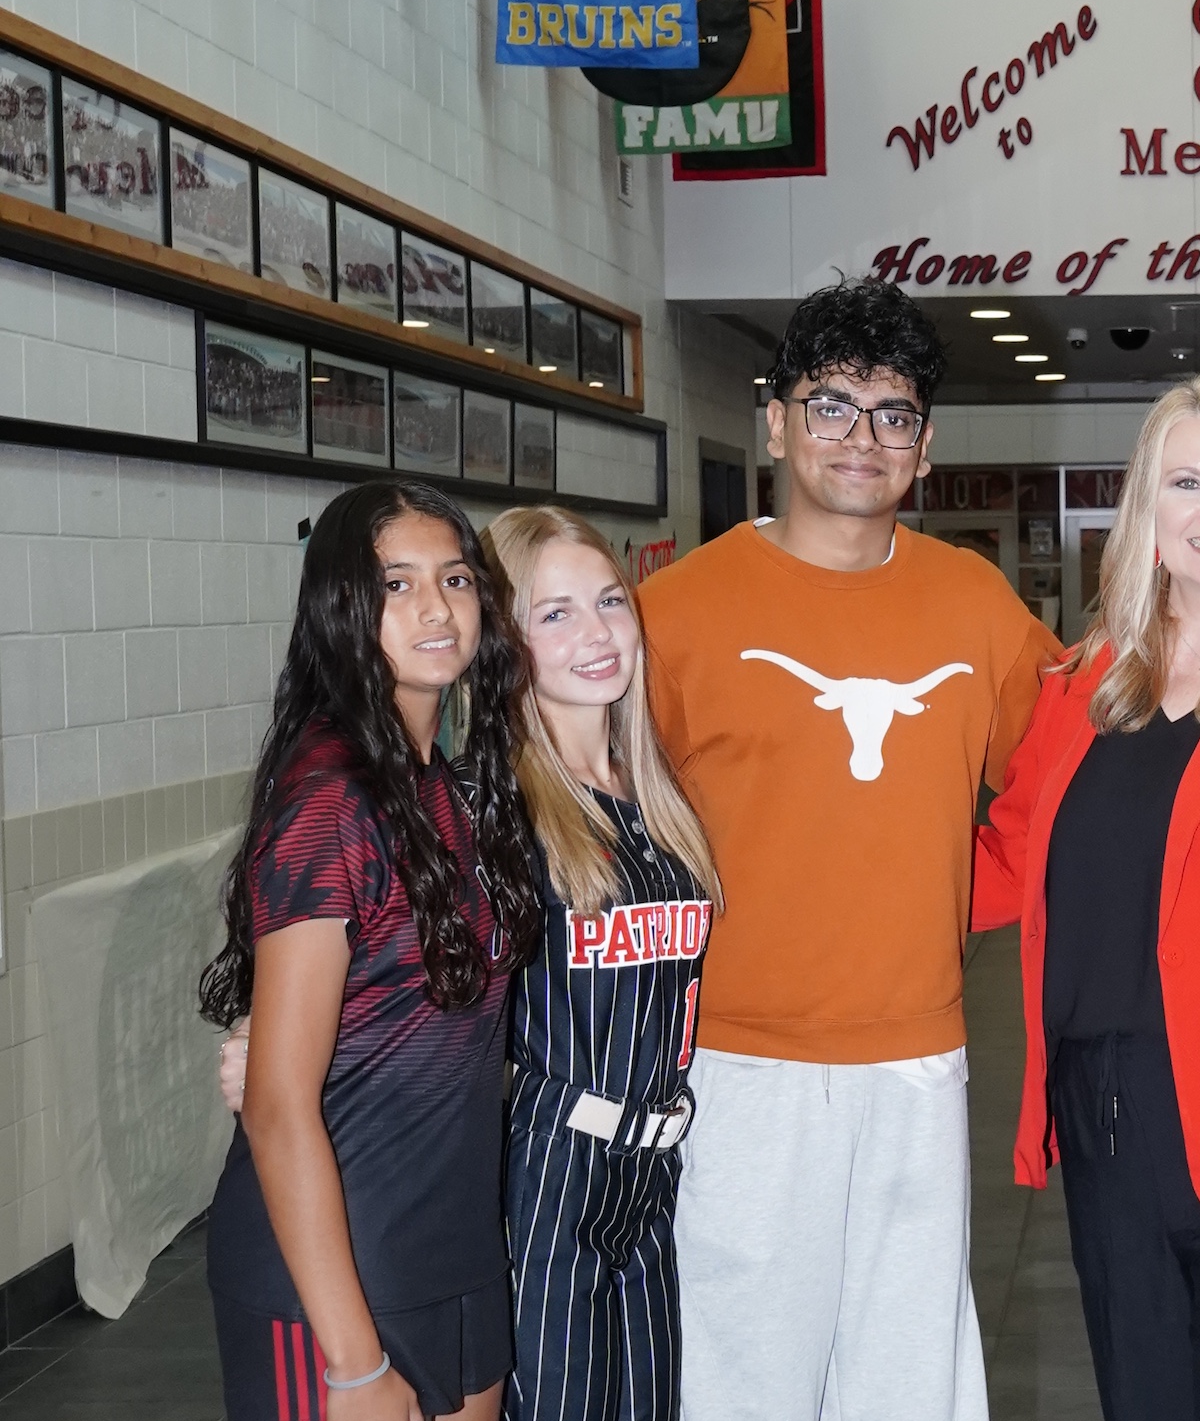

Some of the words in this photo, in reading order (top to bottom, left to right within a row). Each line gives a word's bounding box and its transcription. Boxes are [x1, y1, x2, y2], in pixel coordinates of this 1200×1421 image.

[506, 1, 684, 49] BRUINS
[886, 3, 1098, 172] Welcome
[621, 100, 780, 148] FAMU
[997, 116, 1034, 161] to
[872, 237, 1032, 285] Home
[1056, 238, 1129, 296] of
